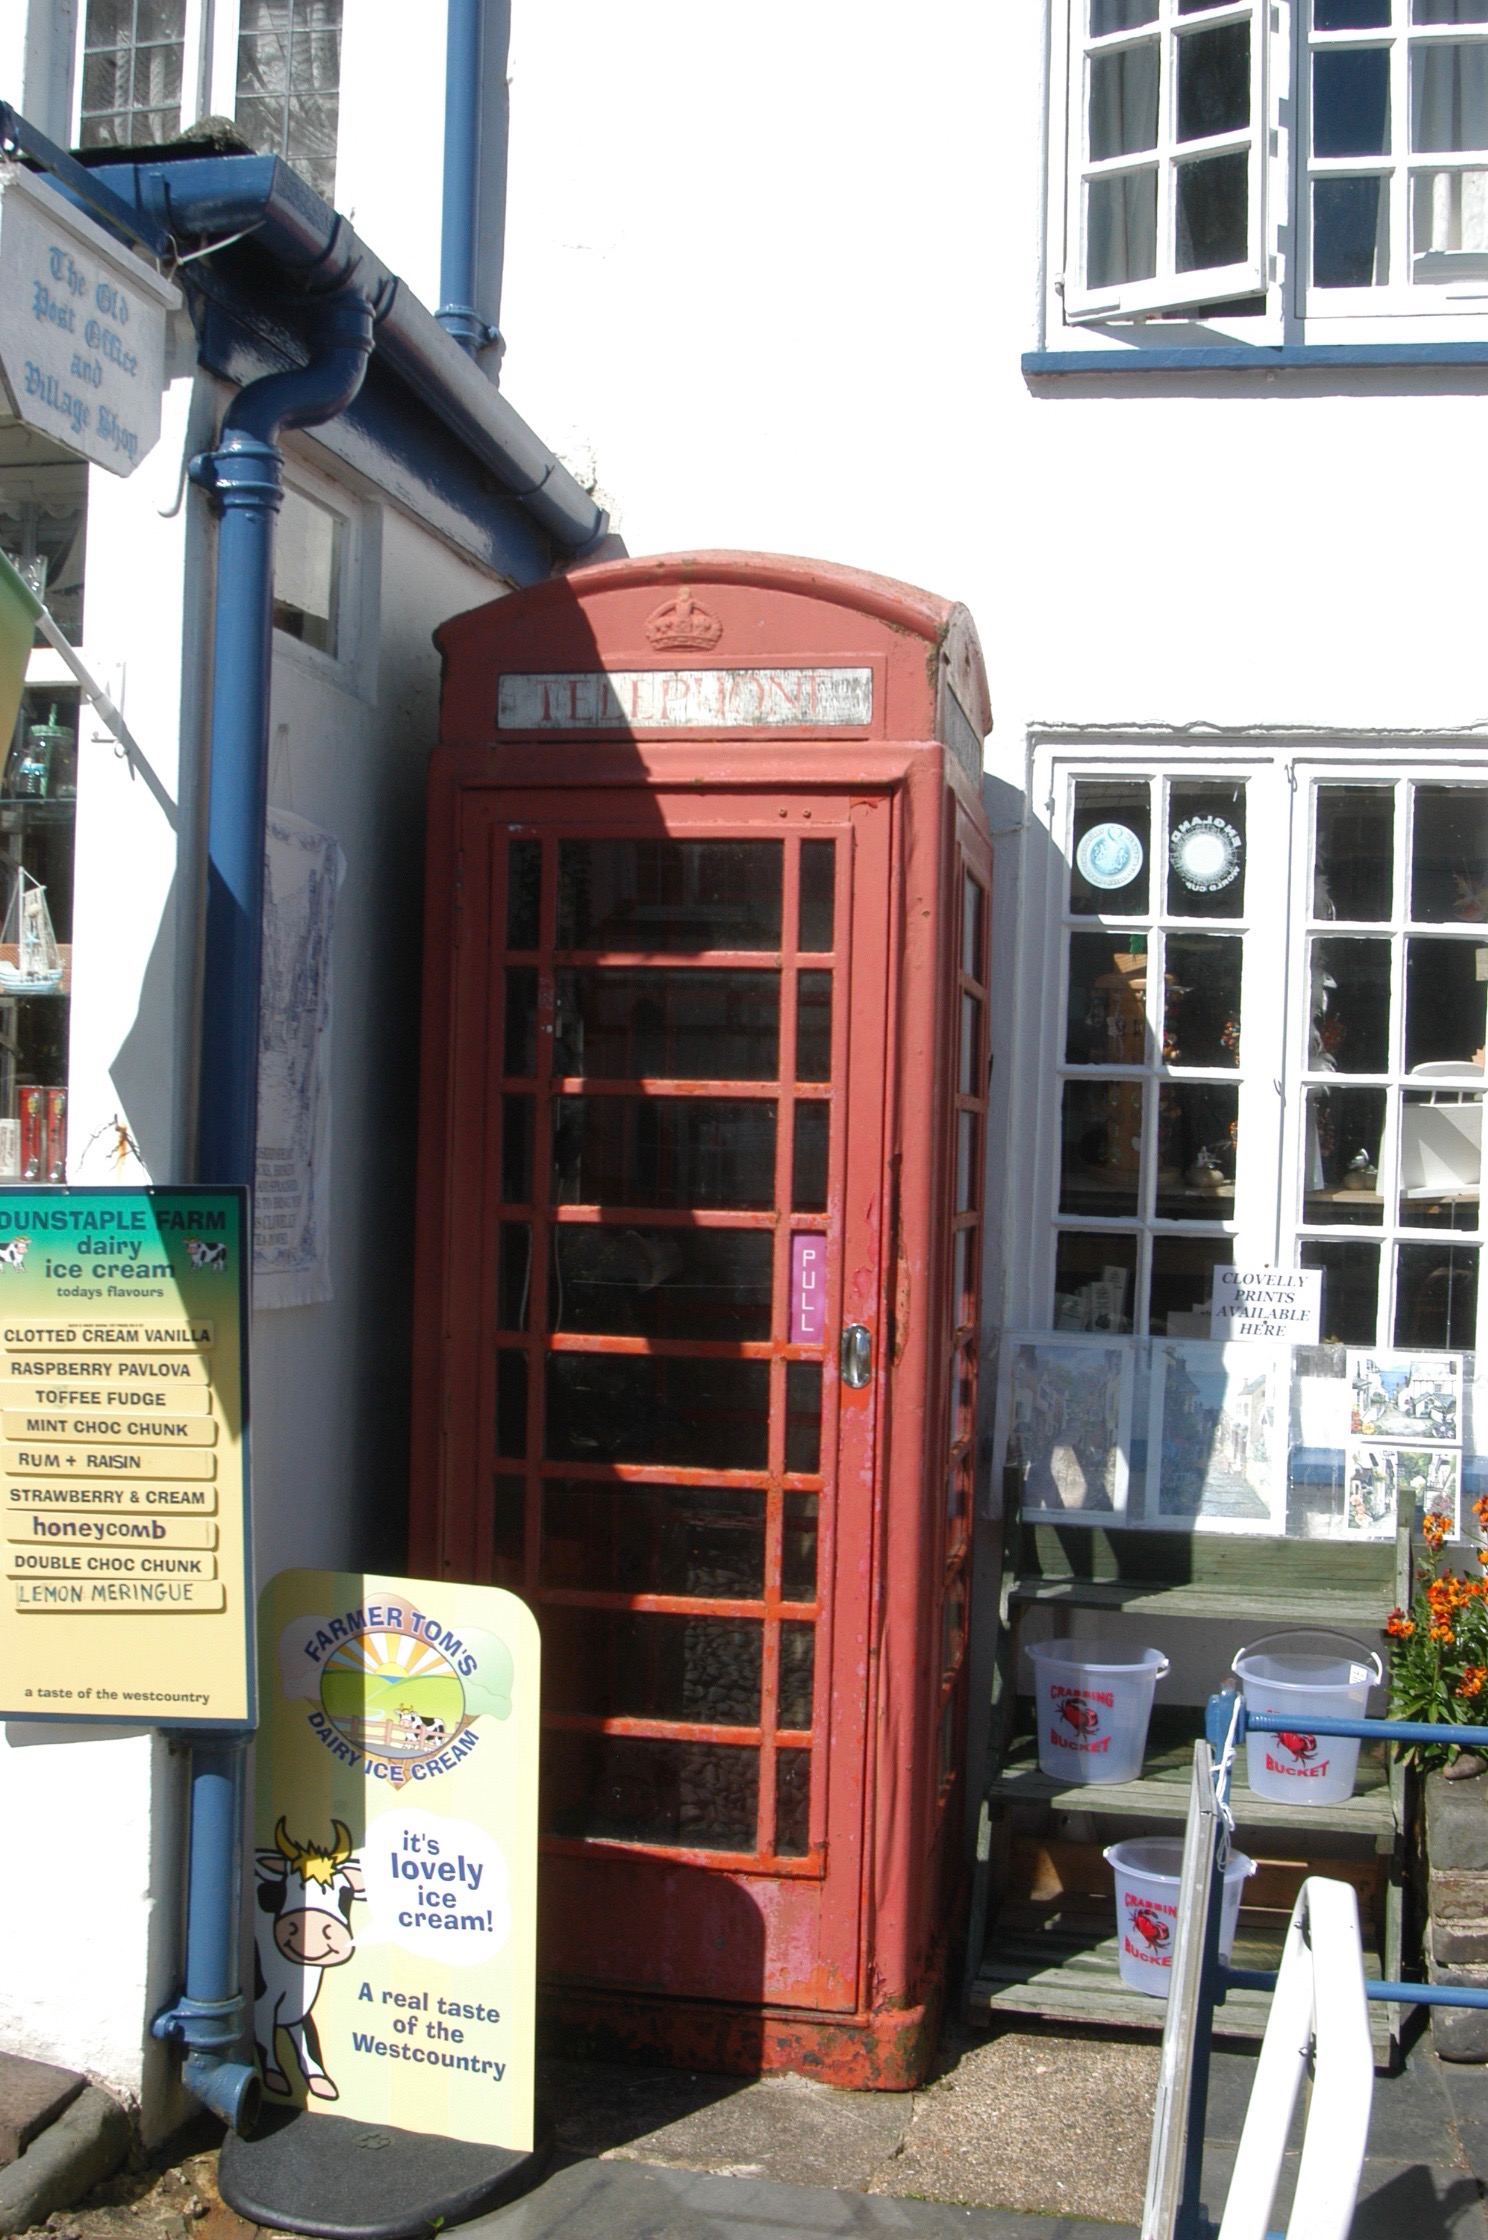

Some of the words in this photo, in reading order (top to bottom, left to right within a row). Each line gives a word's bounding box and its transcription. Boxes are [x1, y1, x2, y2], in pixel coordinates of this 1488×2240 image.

[48, 245, 86, 297] The
[95, 282, 129, 326] Old
[32, 279, 76, 334] Post
[84, 318, 138, 378] Office
[70, 352, 104, 389] and
[24, 360, 90, 434] Village
[98, 404, 138, 459] Shop
[536, 674, 832, 722] TELEPHONE
[0, 1210, 146, 1231] DUNSTAPLE
[156, 1210, 226, 1230] FARM
[77, 1235, 142, 1261] dairy
[45, 1259, 83, 1279] ice
[92, 1262, 176, 1279] cream
[1222, 1272, 1308, 1288] CLOVELLY
[57, 1286, 103, 1300] todays
[107, 1286, 164, 1298] flavours
[801, 1250, 816, 1331] PULL
[1234, 1289, 1296, 1304] PRINTS
[1216, 1305, 1311, 1321] AVAILABLE
[4, 1329, 76, 1343] CLOTTED
[82, 1329, 139, 1343] CREAM
[145, 1329, 211, 1342] VANILLA
[1239, 1323, 1287, 1337] HERE
[10, 1362, 112, 1376] RASPBERRY
[118, 1363, 191, 1377] PAVLOVA
[35, 1390, 102, 1404] TOFFEE
[107, 1392, 167, 1406] FUDGE
[26, 1419, 68, 1432] MINT
[73, 1420, 122, 1434] CHOC
[127, 1422, 188, 1437] CHUNK
[18, 1453, 61, 1468] RUM
[66, 1456, 77, 1467] +
[87, 1455, 141, 1469] RAISIN
[10, 1489, 124, 1504] STRAWBERRY
[129, 1491, 140, 1504] &
[146, 1491, 206, 1505] CREAM
[32, 1516, 167, 1540] honeycomb
[14, 1555, 82, 1570] DOUBLE
[87, 1557, 135, 1571] CHOC
[141, 1559, 203, 1573] CHUNK
[18, 1585, 83, 1603] LEMON
[91, 1583, 194, 1602] MERINGUE
[304, 1606, 404, 1663] FARMER
[411, 1612, 478, 1677] TOM'S
[24, 1688, 33, 1698] a
[37, 1688, 73, 1699] taste
[77, 1687, 93, 1699] of
[96, 1688, 118, 1701] the
[123, 1691, 210, 1705] westcountry
[307, 1711, 362, 1768] DAIRY
[363, 1760, 404, 1782] ICE
[411, 1729, 480, 1781] CREAM
[1050, 1727, 1112, 1753] BUCKET
[1265, 1753, 1330, 1777] BUCKET
[403, 1830, 440, 1856] it's
[391, 1852, 484, 1890] lovely
[418, 1885, 457, 1909] ice
[1124, 1891, 1178, 1918] CRABBIN
[399, 1910, 493, 1932] cream!
[1124, 1935, 1173, 1967] BUCKE
[358, 1982, 373, 2002] A
[382, 1991, 429, 2012] real
[437, 1997, 501, 2023] taste
[393, 2016, 419, 2035] of
[425, 2021, 465, 2043] the
[352, 2032, 506, 2082] Westcountry
